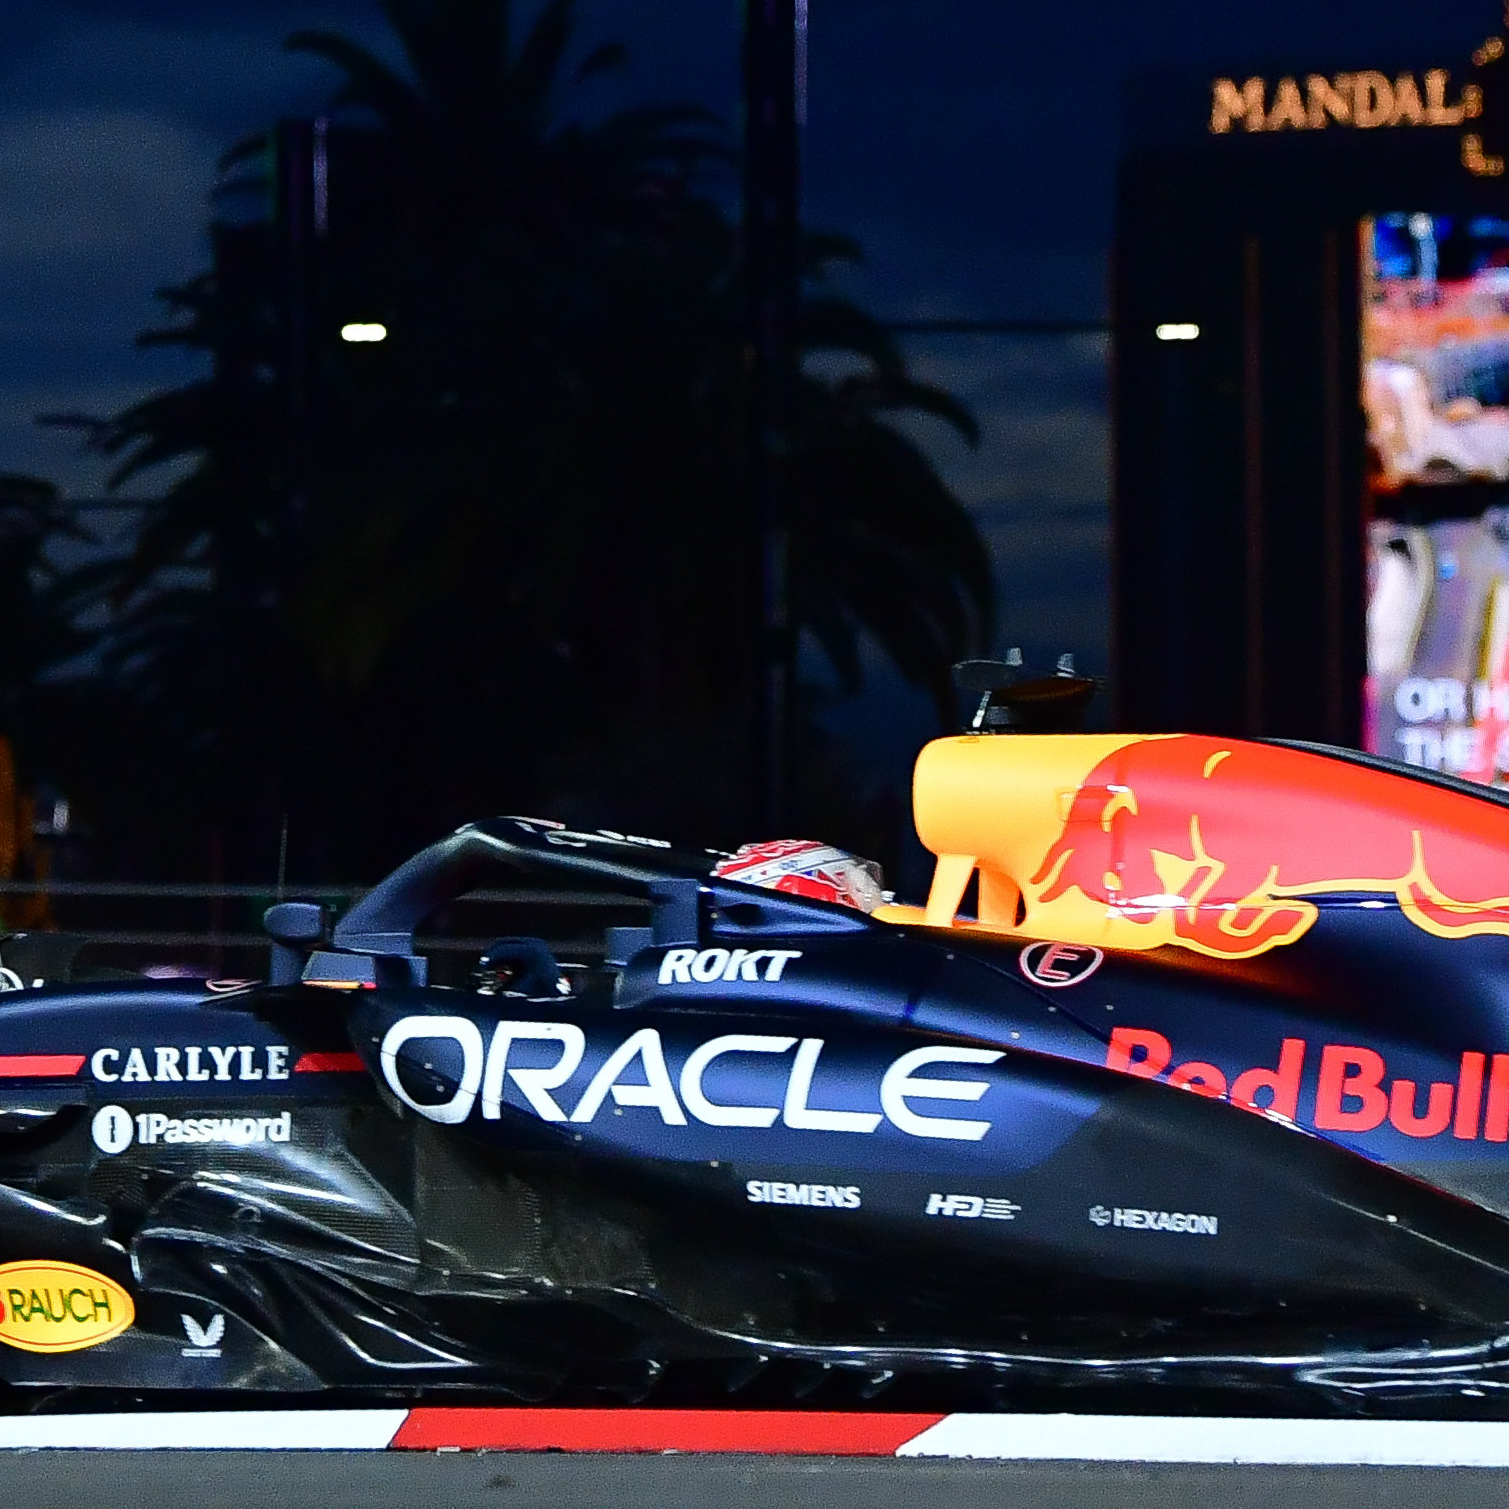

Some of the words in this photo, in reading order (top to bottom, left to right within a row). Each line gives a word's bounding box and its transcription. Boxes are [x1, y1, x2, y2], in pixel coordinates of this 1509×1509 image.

[1209, 69, 1466, 134] MANDAL
[657, 948, 802, 985] ROKT
[90, 1045, 290, 1083] CARLYLE
[380, 1015, 1006, 1142] ORACLE
[135, 1111, 291, 1145] 1Password
[746, 1180, 862, 1210] SIEMENS
[1113, 1207, 1219, 1236] HEXAGON
[8, 1287, 113, 1325] RAUCH
